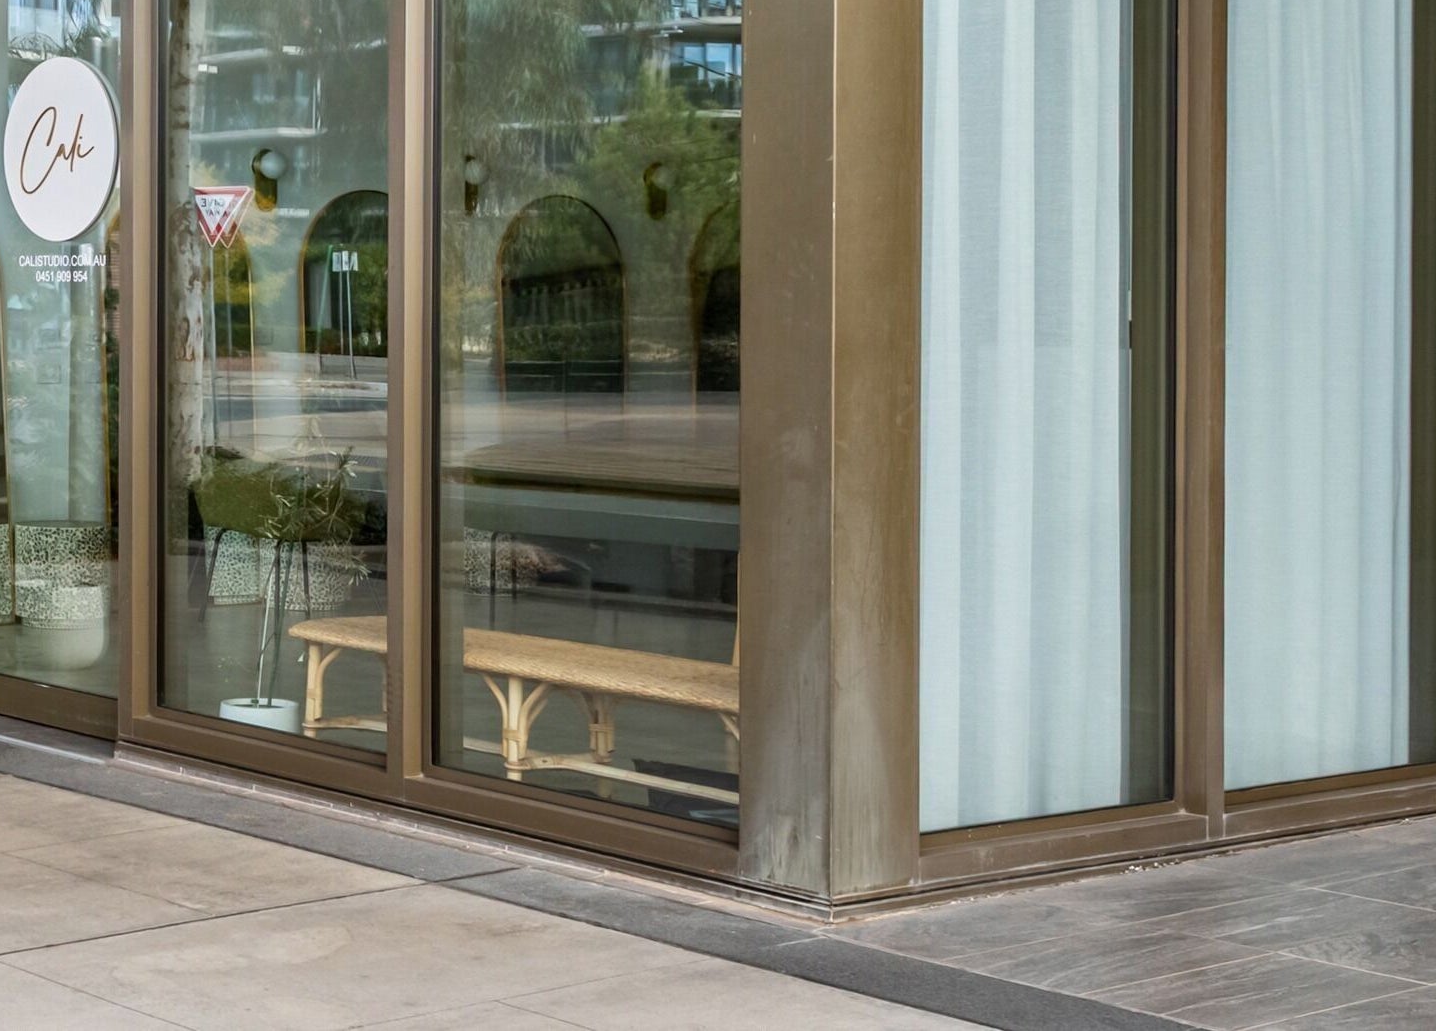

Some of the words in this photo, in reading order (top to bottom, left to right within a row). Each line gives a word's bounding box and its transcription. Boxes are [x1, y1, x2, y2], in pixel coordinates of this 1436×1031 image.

[19, 106, 95, 195] Cali
[35, 270, 54, 282] 0451
[56, 271, 71, 282] 909
[72, 271, 88, 282] 954
